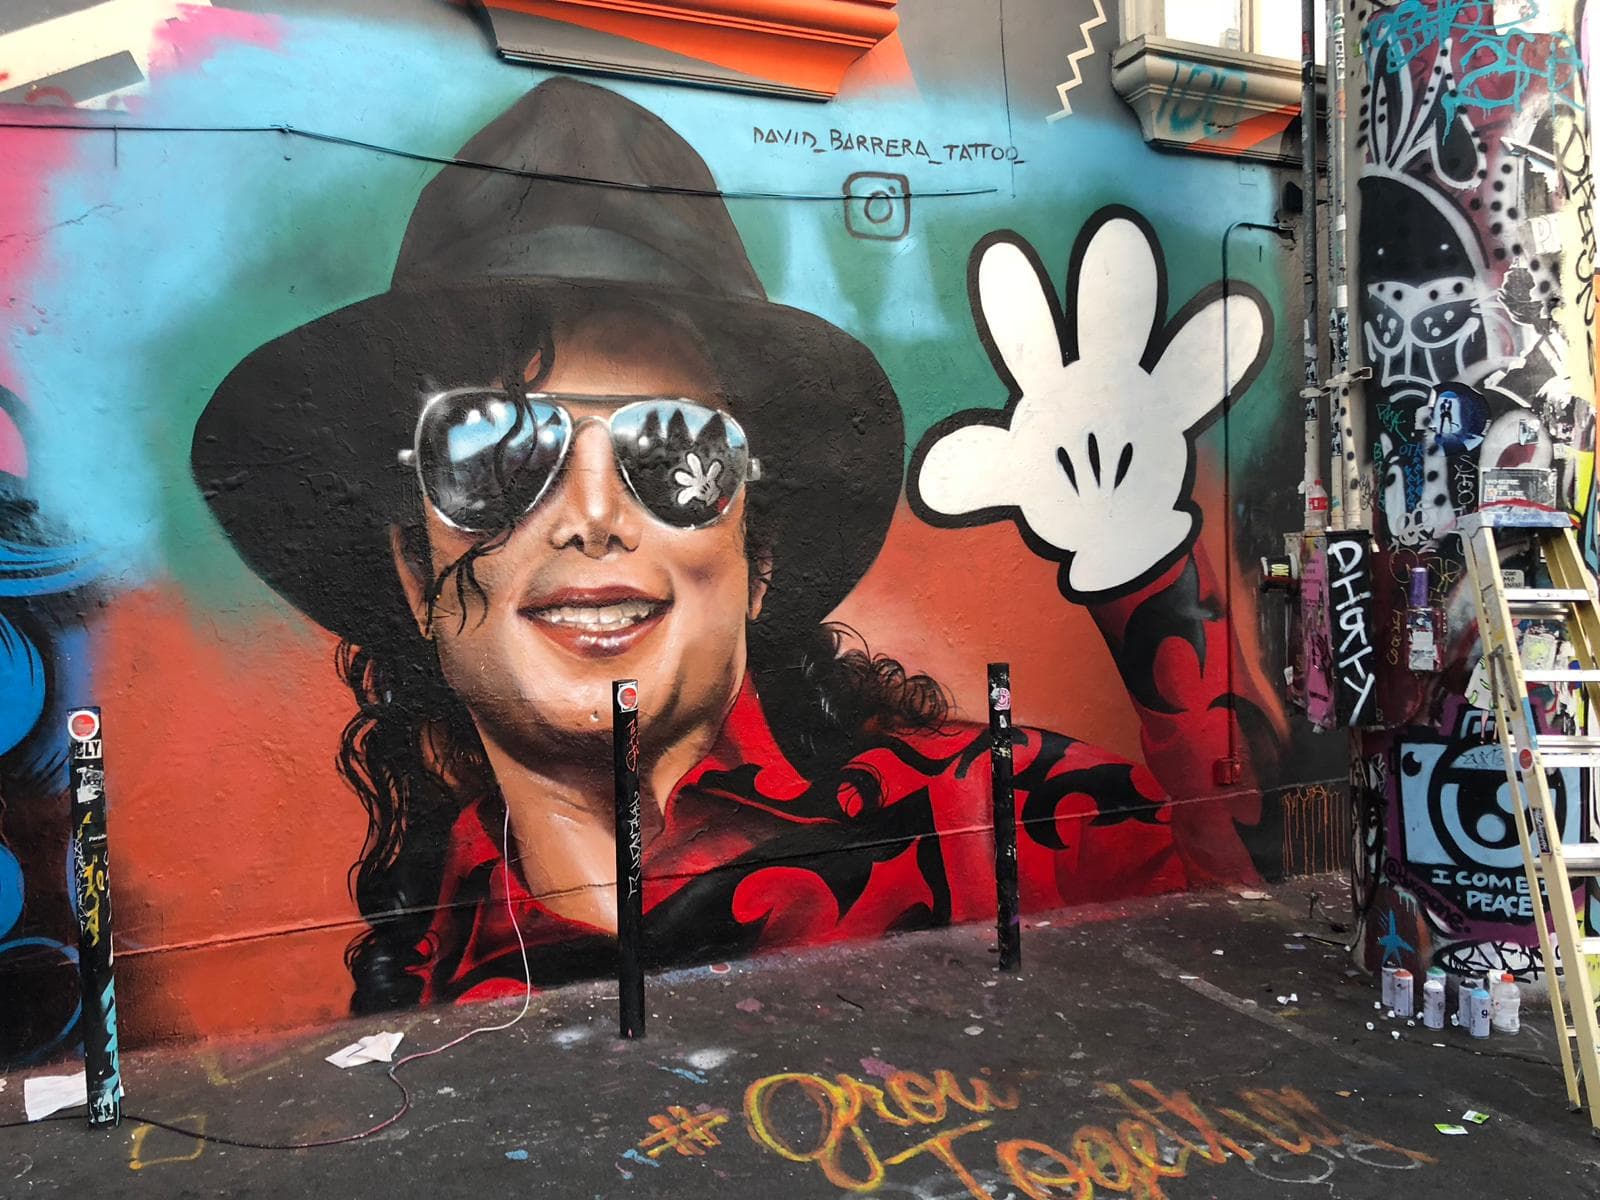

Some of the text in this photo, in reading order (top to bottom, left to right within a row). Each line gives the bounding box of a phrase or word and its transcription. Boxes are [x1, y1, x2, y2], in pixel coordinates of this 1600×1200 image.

[1431, 868, 1452, 885] I
[1455, 870, 1530, 894] COME
[1466, 890, 1534, 917] PEACE
